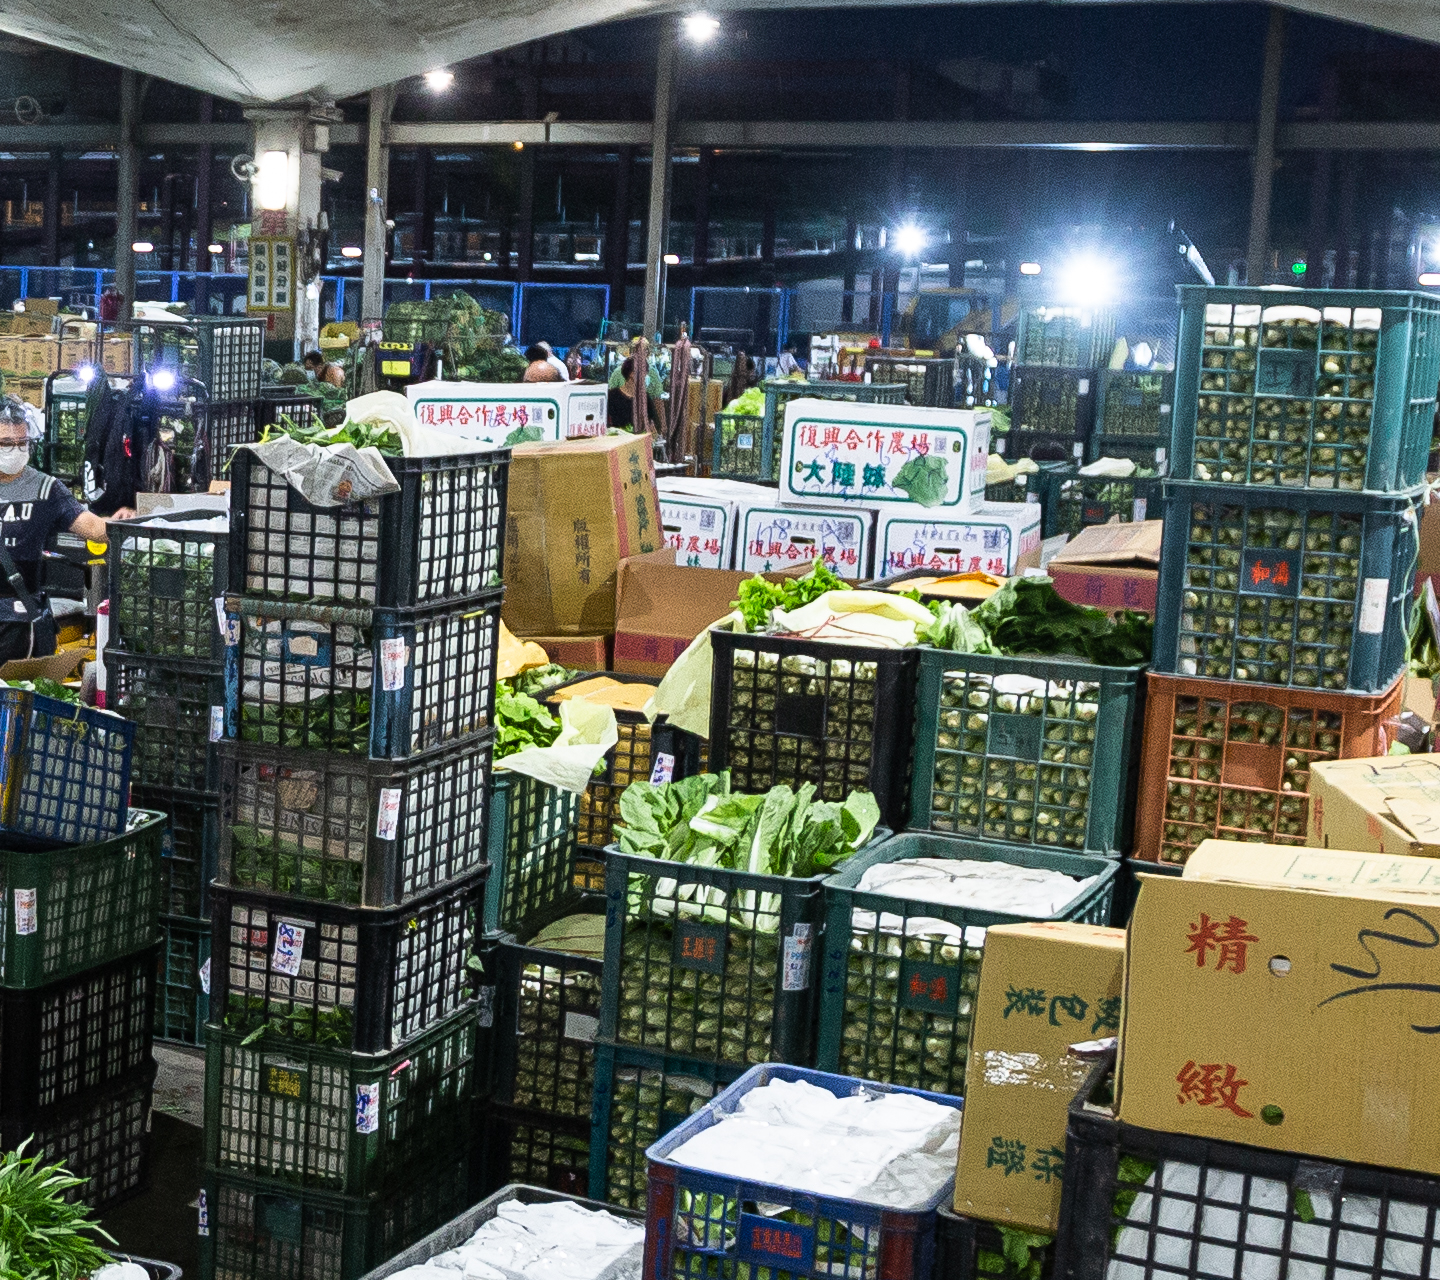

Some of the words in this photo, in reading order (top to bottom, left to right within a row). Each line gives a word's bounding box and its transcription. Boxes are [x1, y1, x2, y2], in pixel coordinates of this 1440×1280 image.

[799, 424, 931, 456] 復興合作農場
